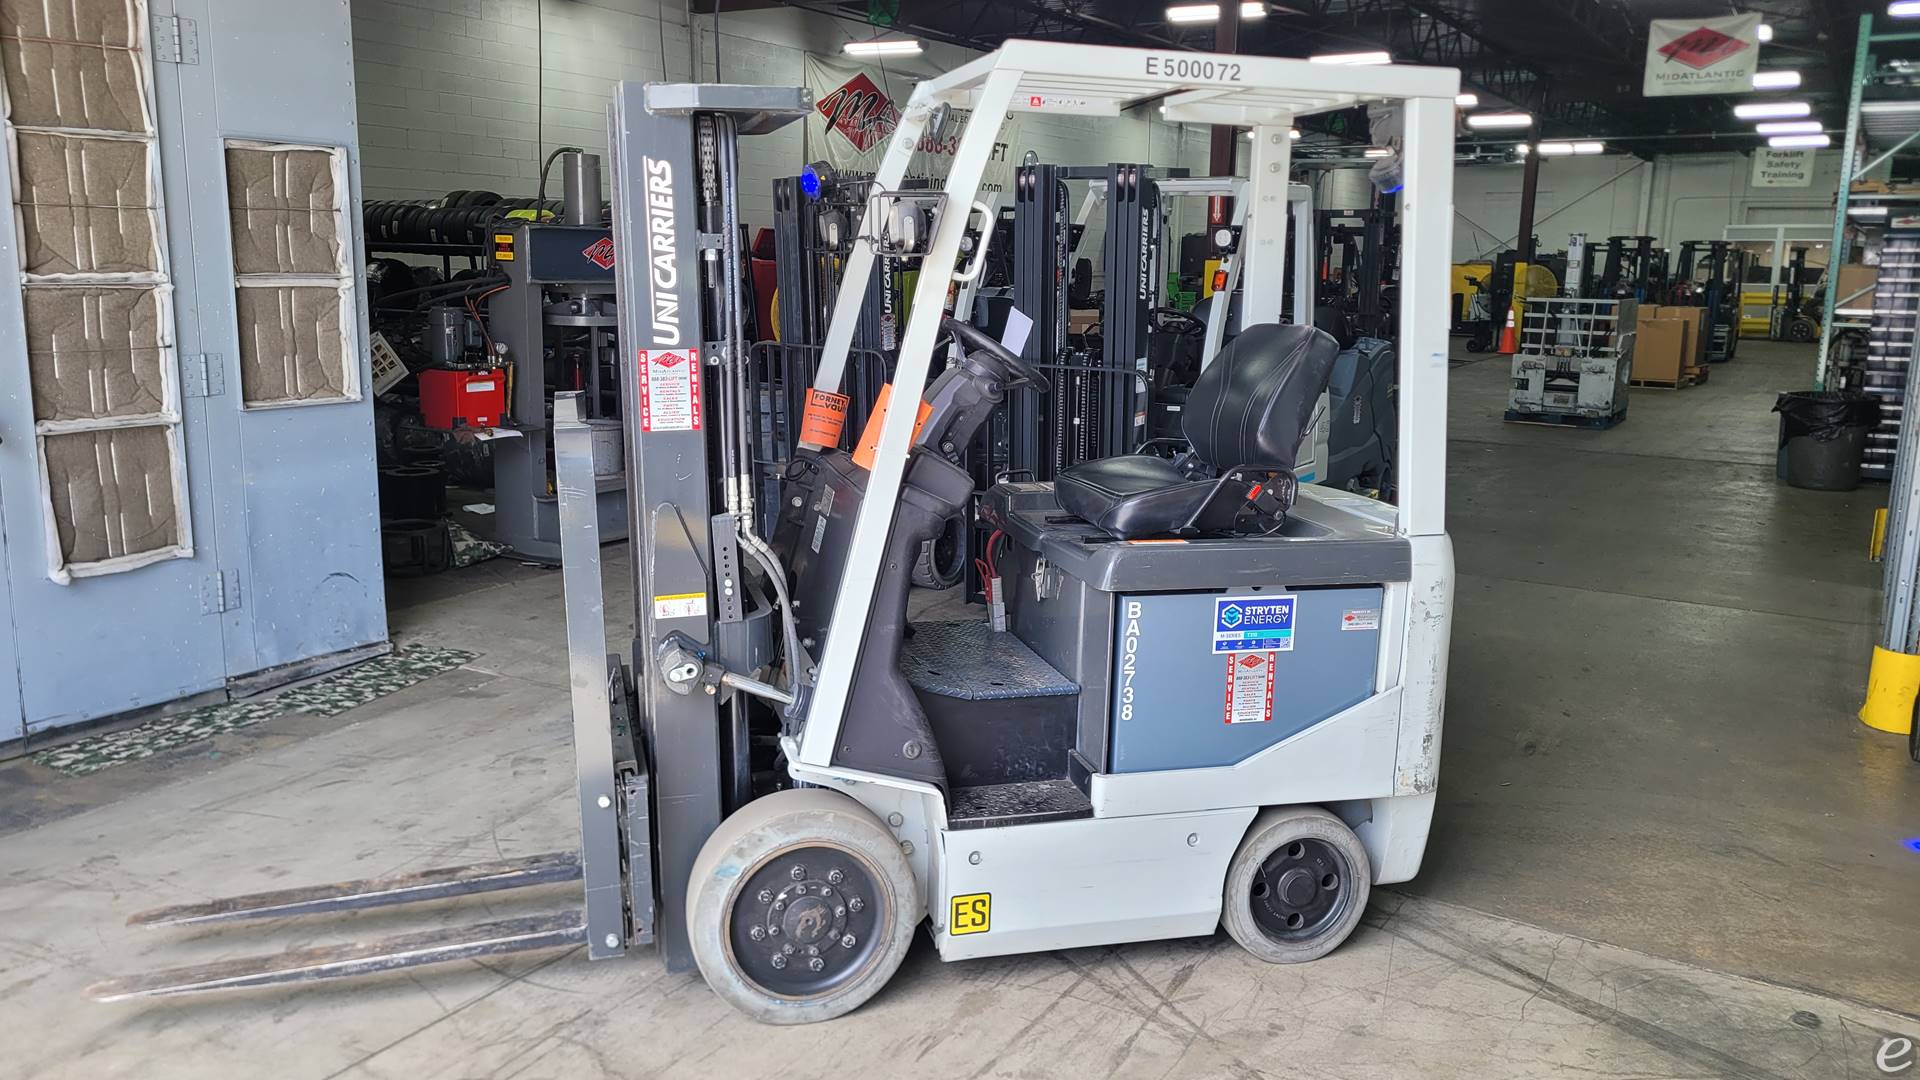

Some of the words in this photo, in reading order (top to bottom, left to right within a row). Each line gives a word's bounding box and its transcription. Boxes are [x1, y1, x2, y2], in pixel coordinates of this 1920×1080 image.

[1656, 69, 1745, 81] MIDATLANTIC
[1766, 150, 1804, 158] Forklift
[1767, 161, 1801, 169] Safety
[1760, 171, 1805, 180] Training
[640, 353, 649, 428] SERVICE
[690, 352, 700, 426] RENTALS
[815, 393, 845, 407] FORNEY
[1245, 605, 1289, 615] STRYTEN
[1244, 614, 1289, 625] ENERGY
[1121, 601, 1142, 721] BA02738
[1226, 656, 1234, 720] SERVICE
[1265, 654, 1274, 717] RENTALS
[955, 899, 986, 929] ES
